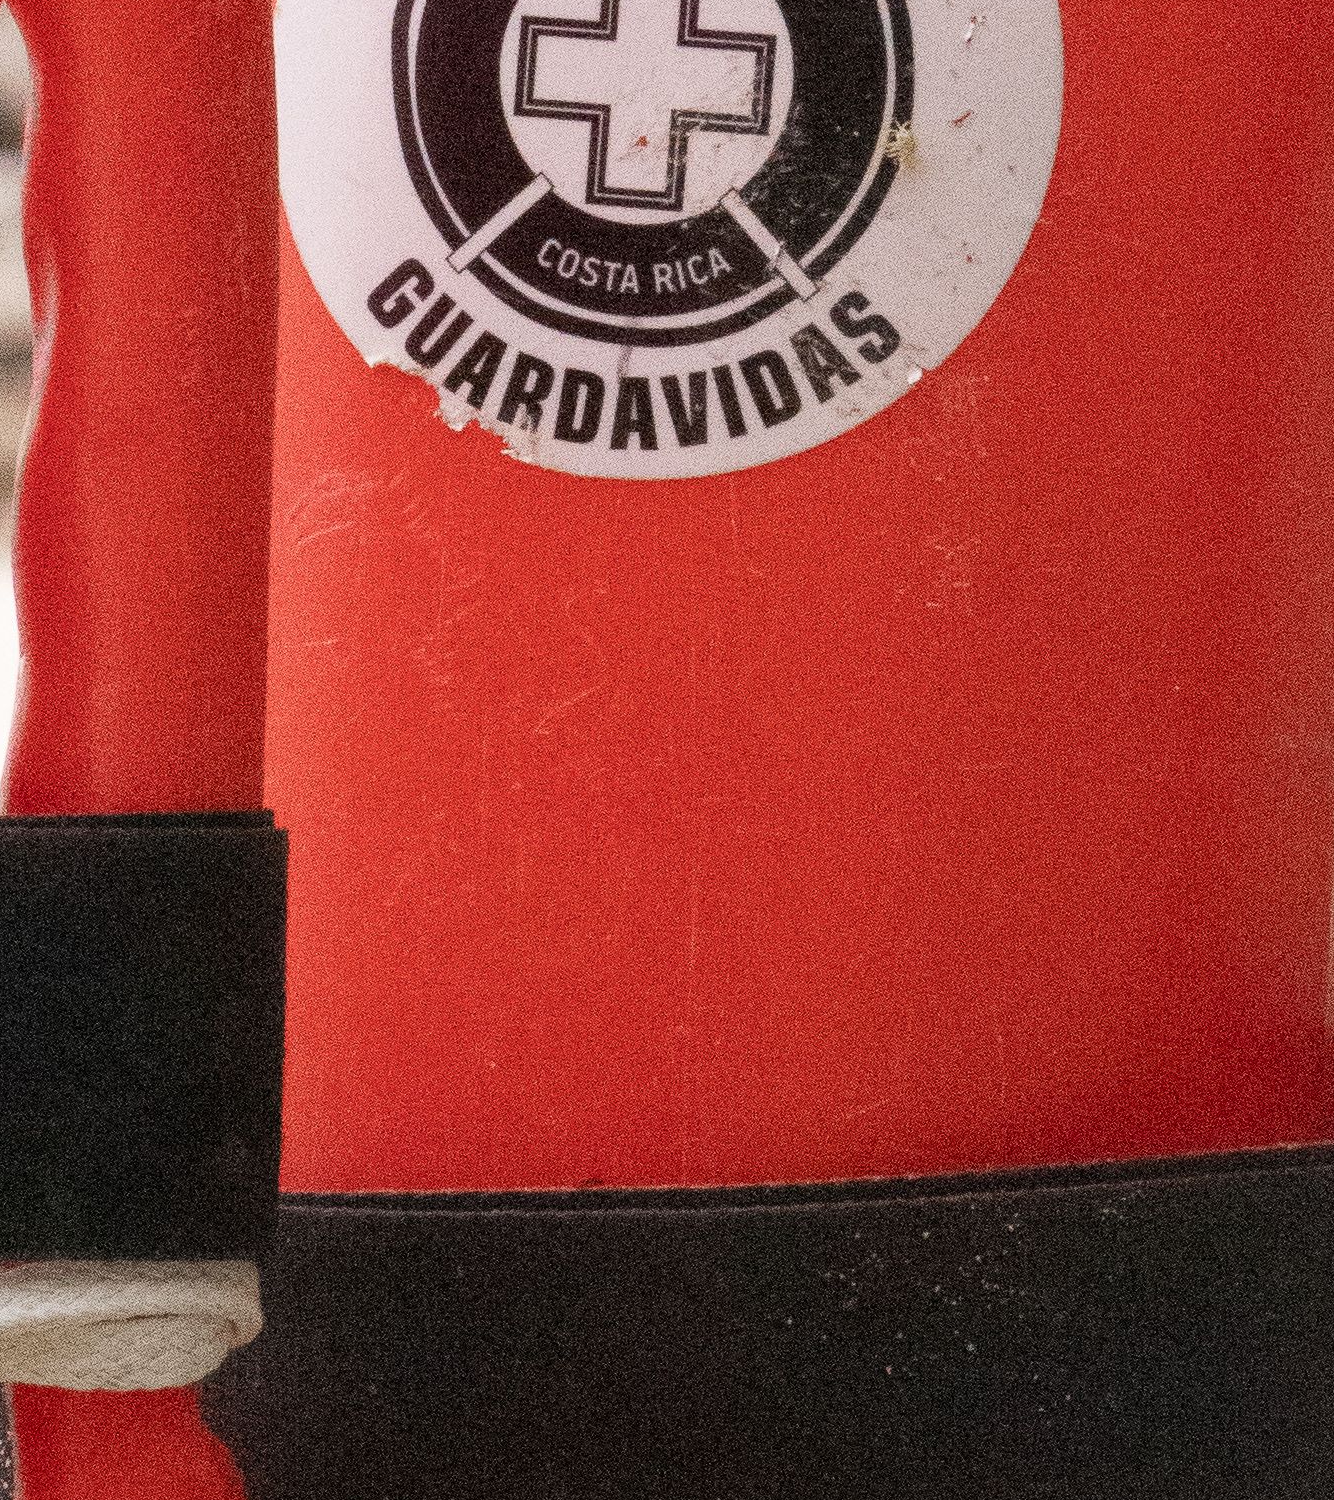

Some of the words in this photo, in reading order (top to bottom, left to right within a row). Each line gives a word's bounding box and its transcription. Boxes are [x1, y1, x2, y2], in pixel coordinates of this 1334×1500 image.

[536, 236, 641, 295] COSTA
[652, 247, 734, 294] RICA
[366, 255, 901, 452] GUARDAVIDAS
